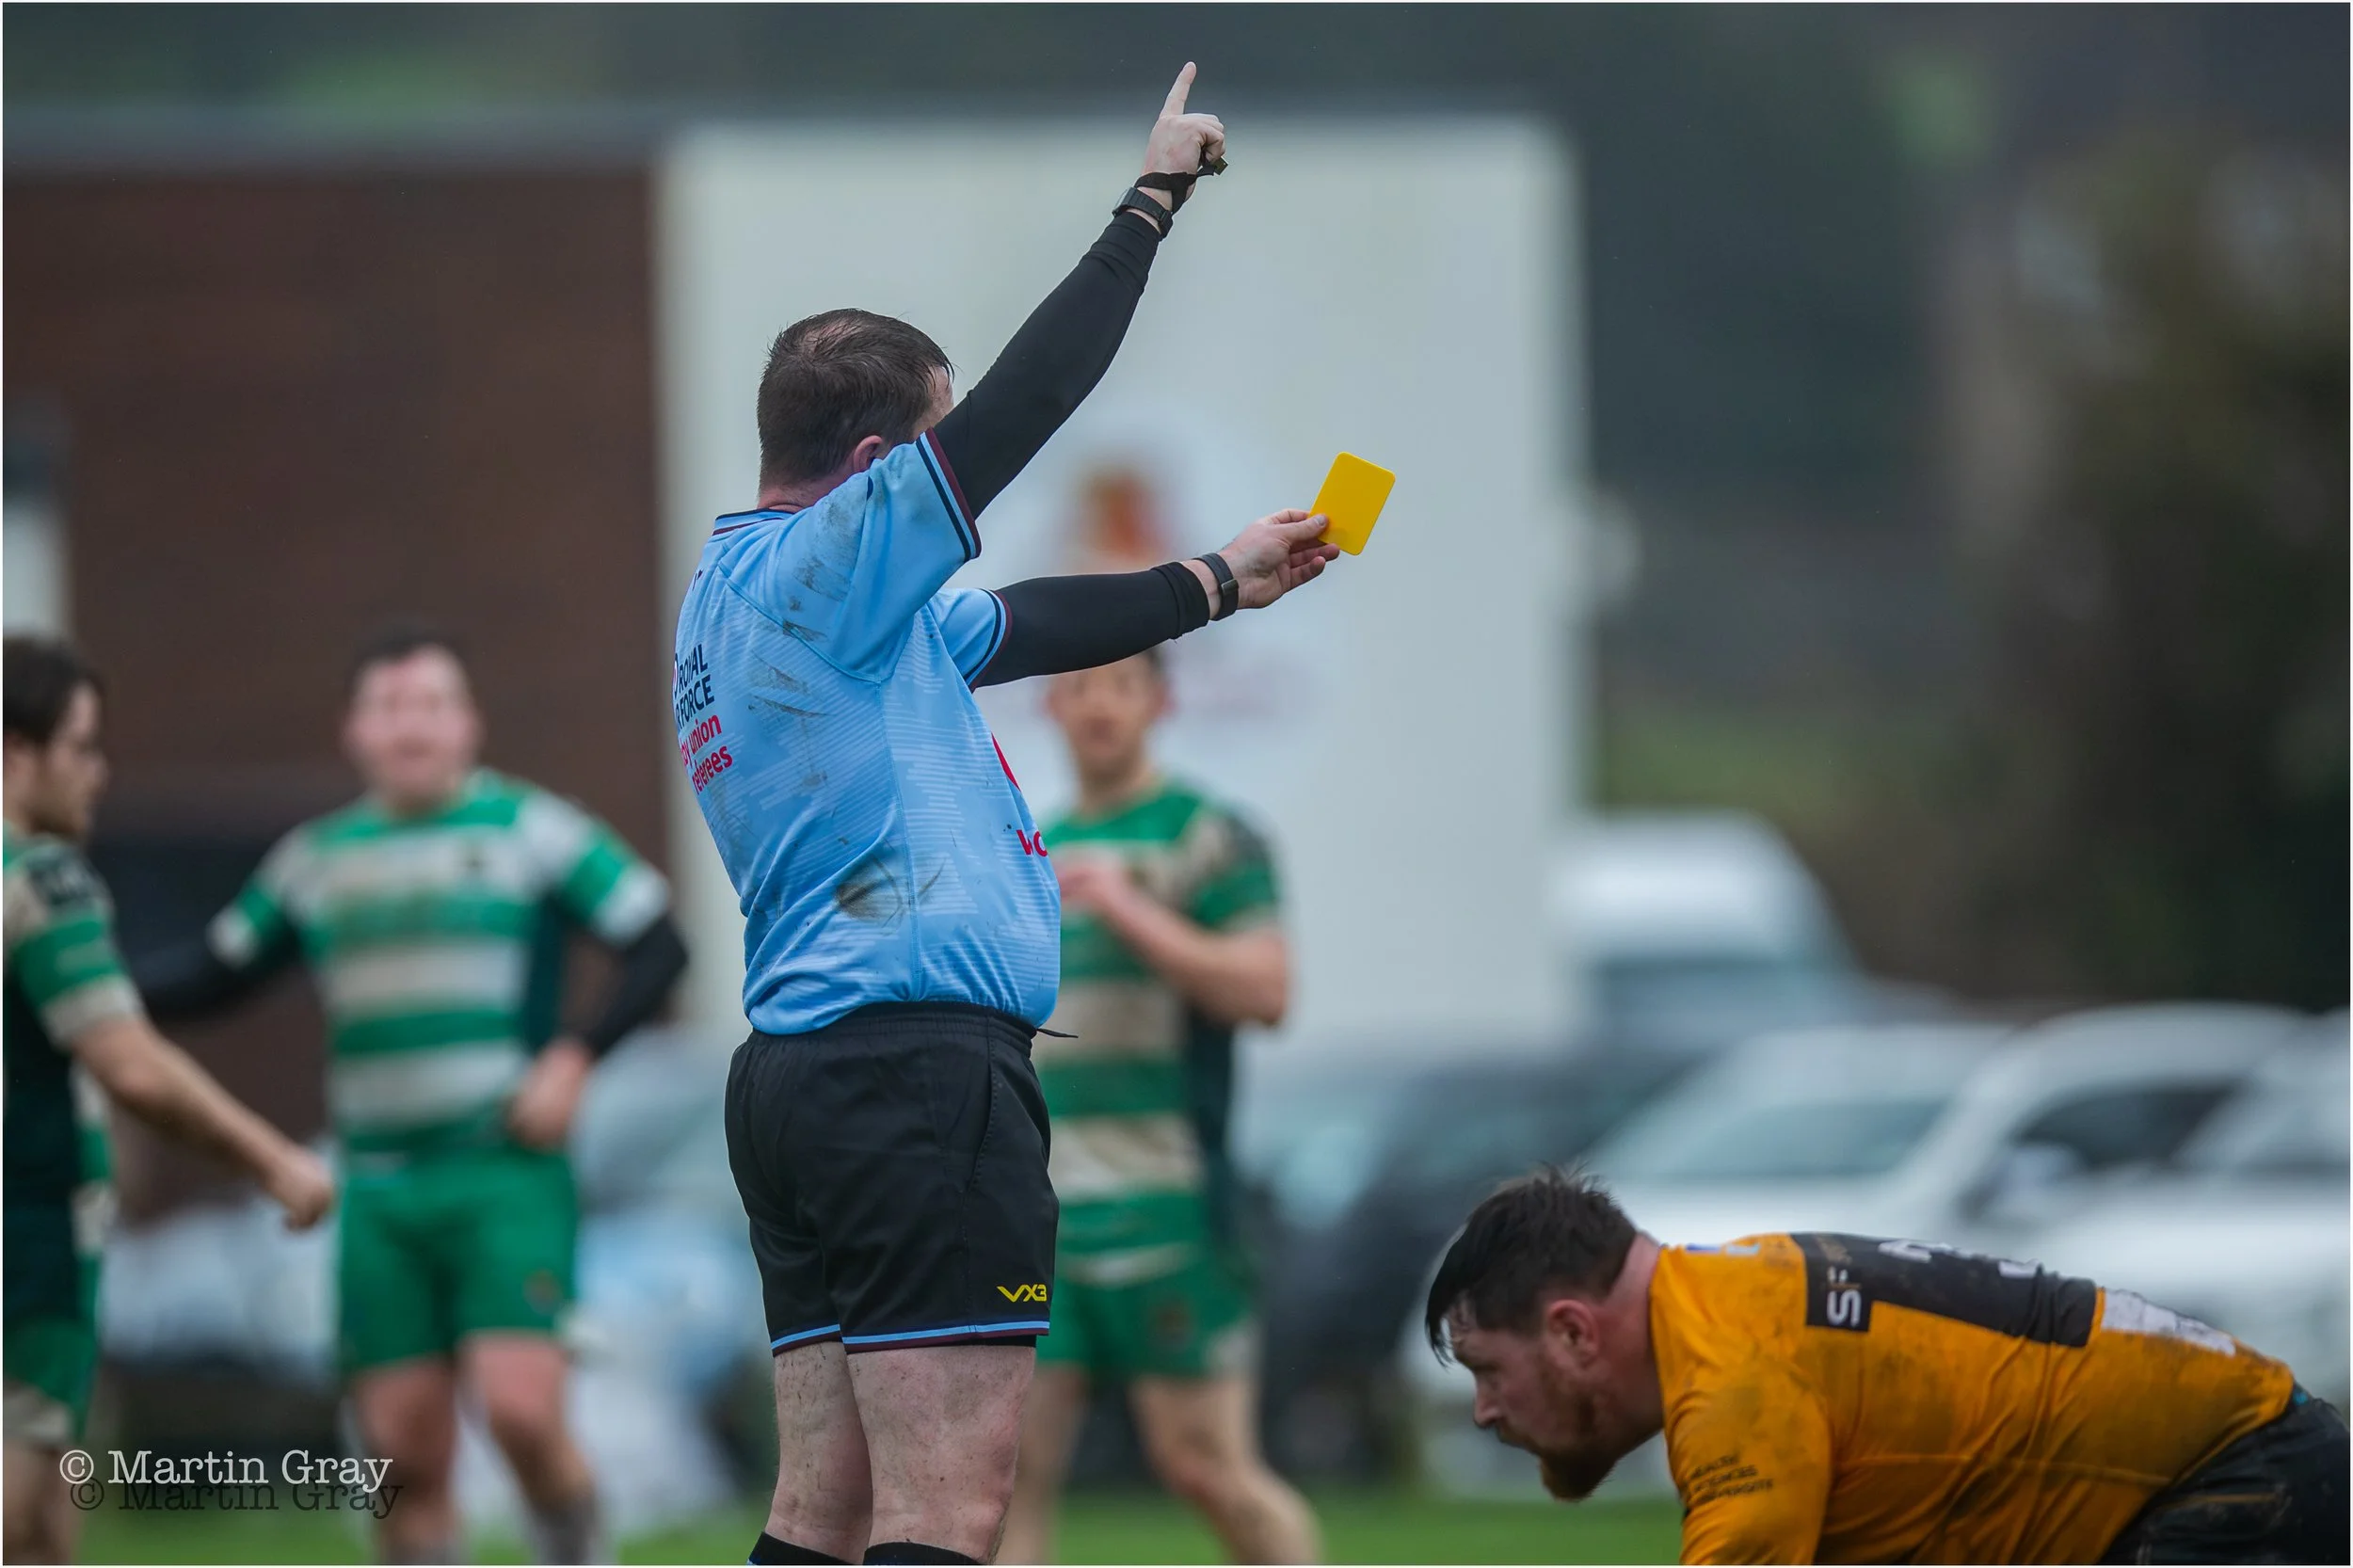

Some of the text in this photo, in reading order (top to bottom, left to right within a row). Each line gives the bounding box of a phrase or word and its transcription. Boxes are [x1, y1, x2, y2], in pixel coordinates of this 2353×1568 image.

[679, 644, 708, 694] ROYAL
[680, 674, 715, 727] FORCE
[688, 715, 722, 755] union
[692, 745, 733, 795] referees
[997, 1284, 1048, 1303] VX3
